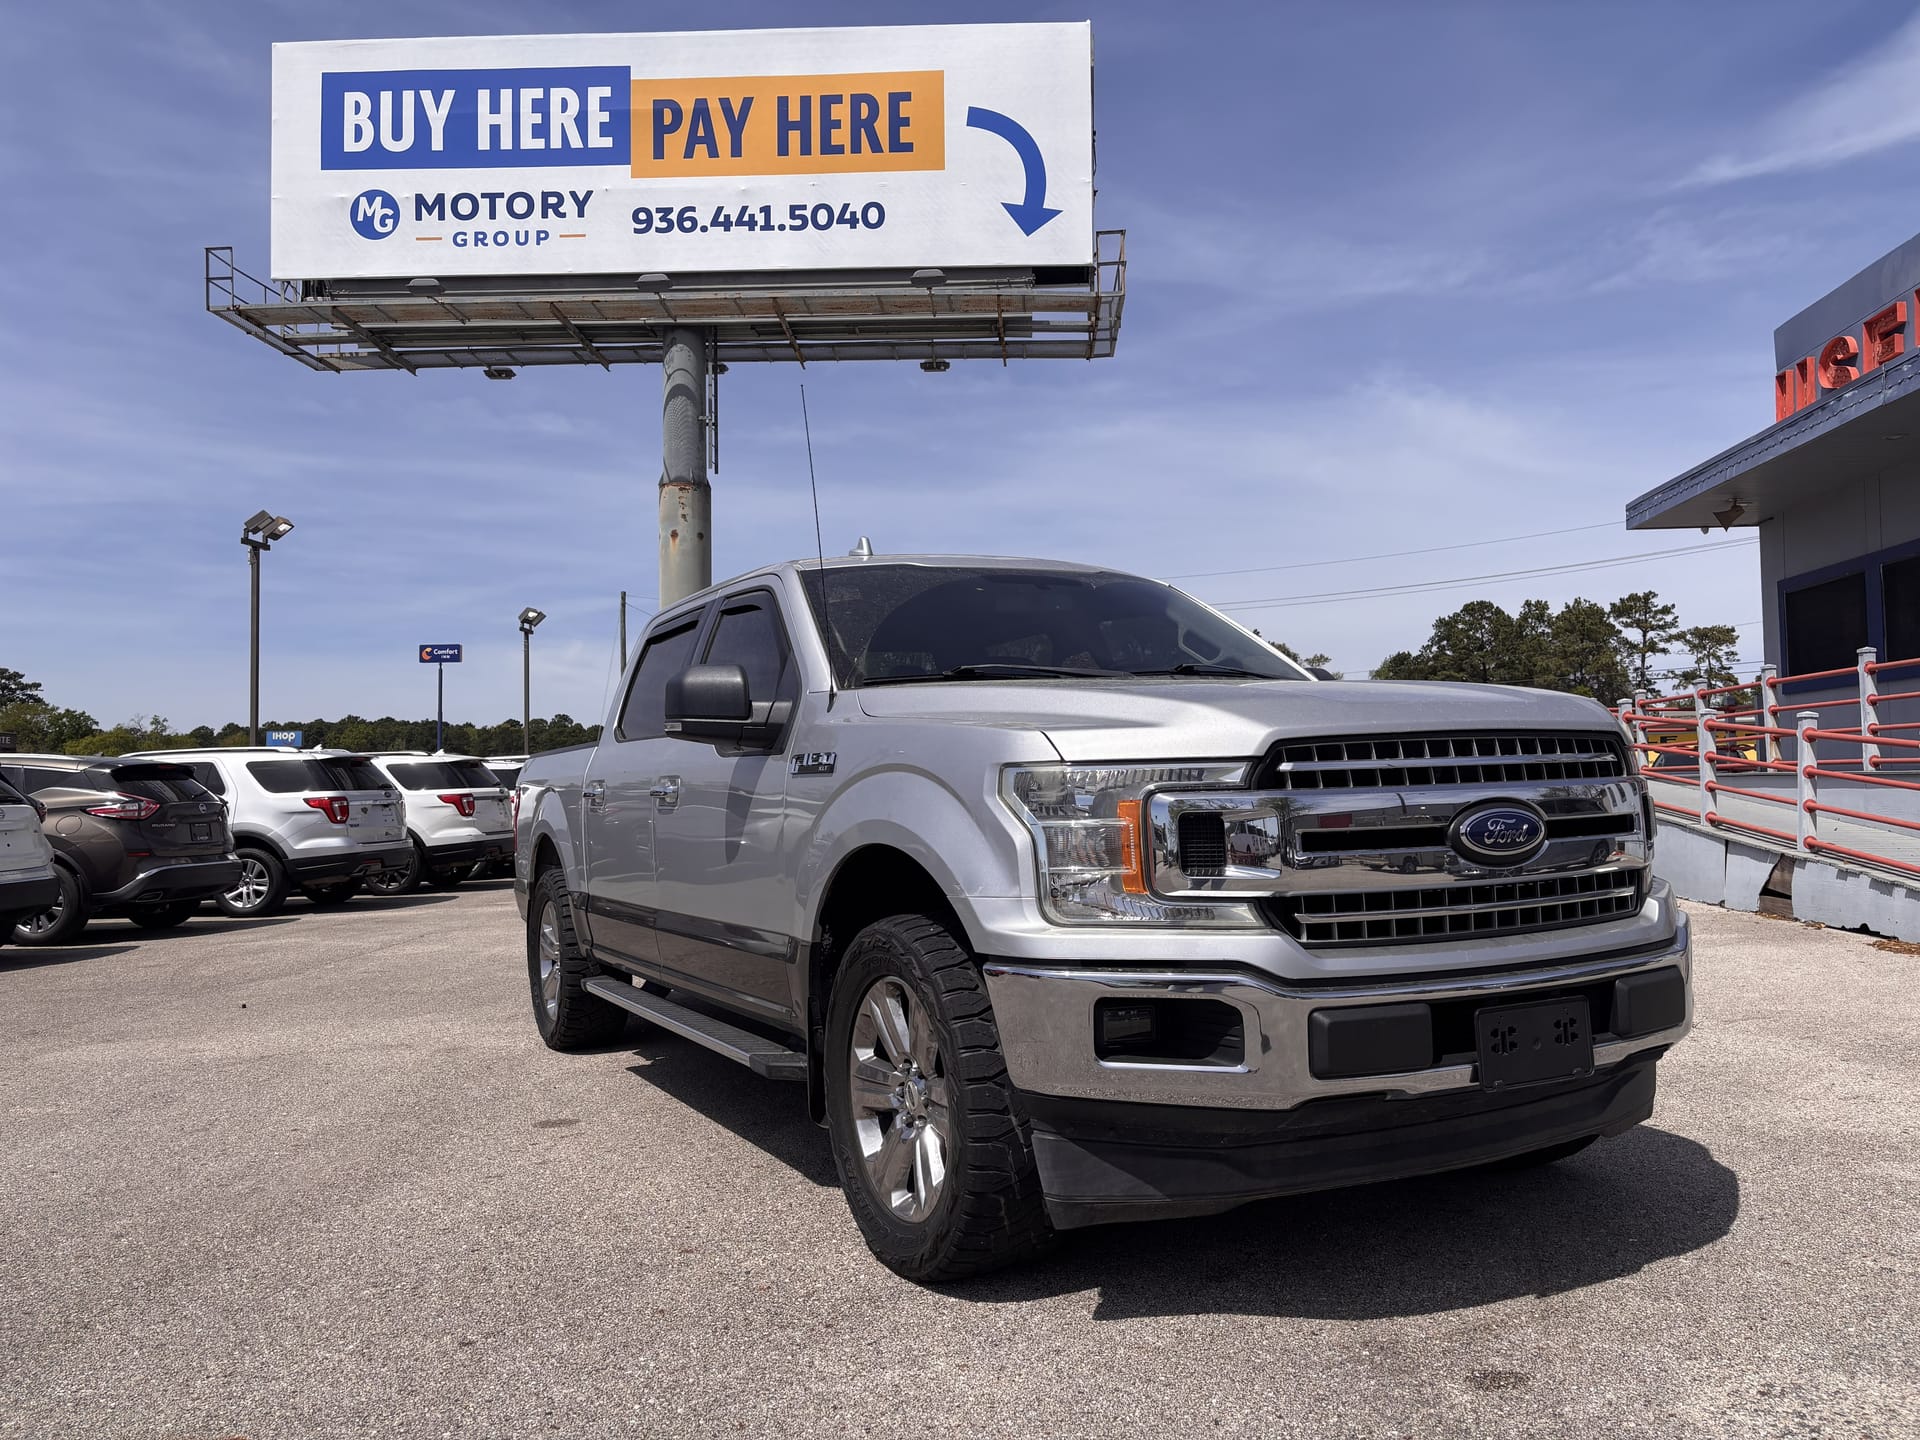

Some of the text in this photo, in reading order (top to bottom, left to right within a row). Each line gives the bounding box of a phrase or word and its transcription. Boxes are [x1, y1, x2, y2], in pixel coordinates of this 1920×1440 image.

[343, 86, 614, 153] BUY HERE
[652, 91, 914, 160] PAY HERE
[357, 196, 394, 233] MG
[415, 189, 594, 222] MOTORY
[632, 201, 886, 235] 936.441.5040
[452, 230, 550, 248] GROUP
[1775, 288, 1920, 424] USE
[1484, 818, 1529, 845] Ford
